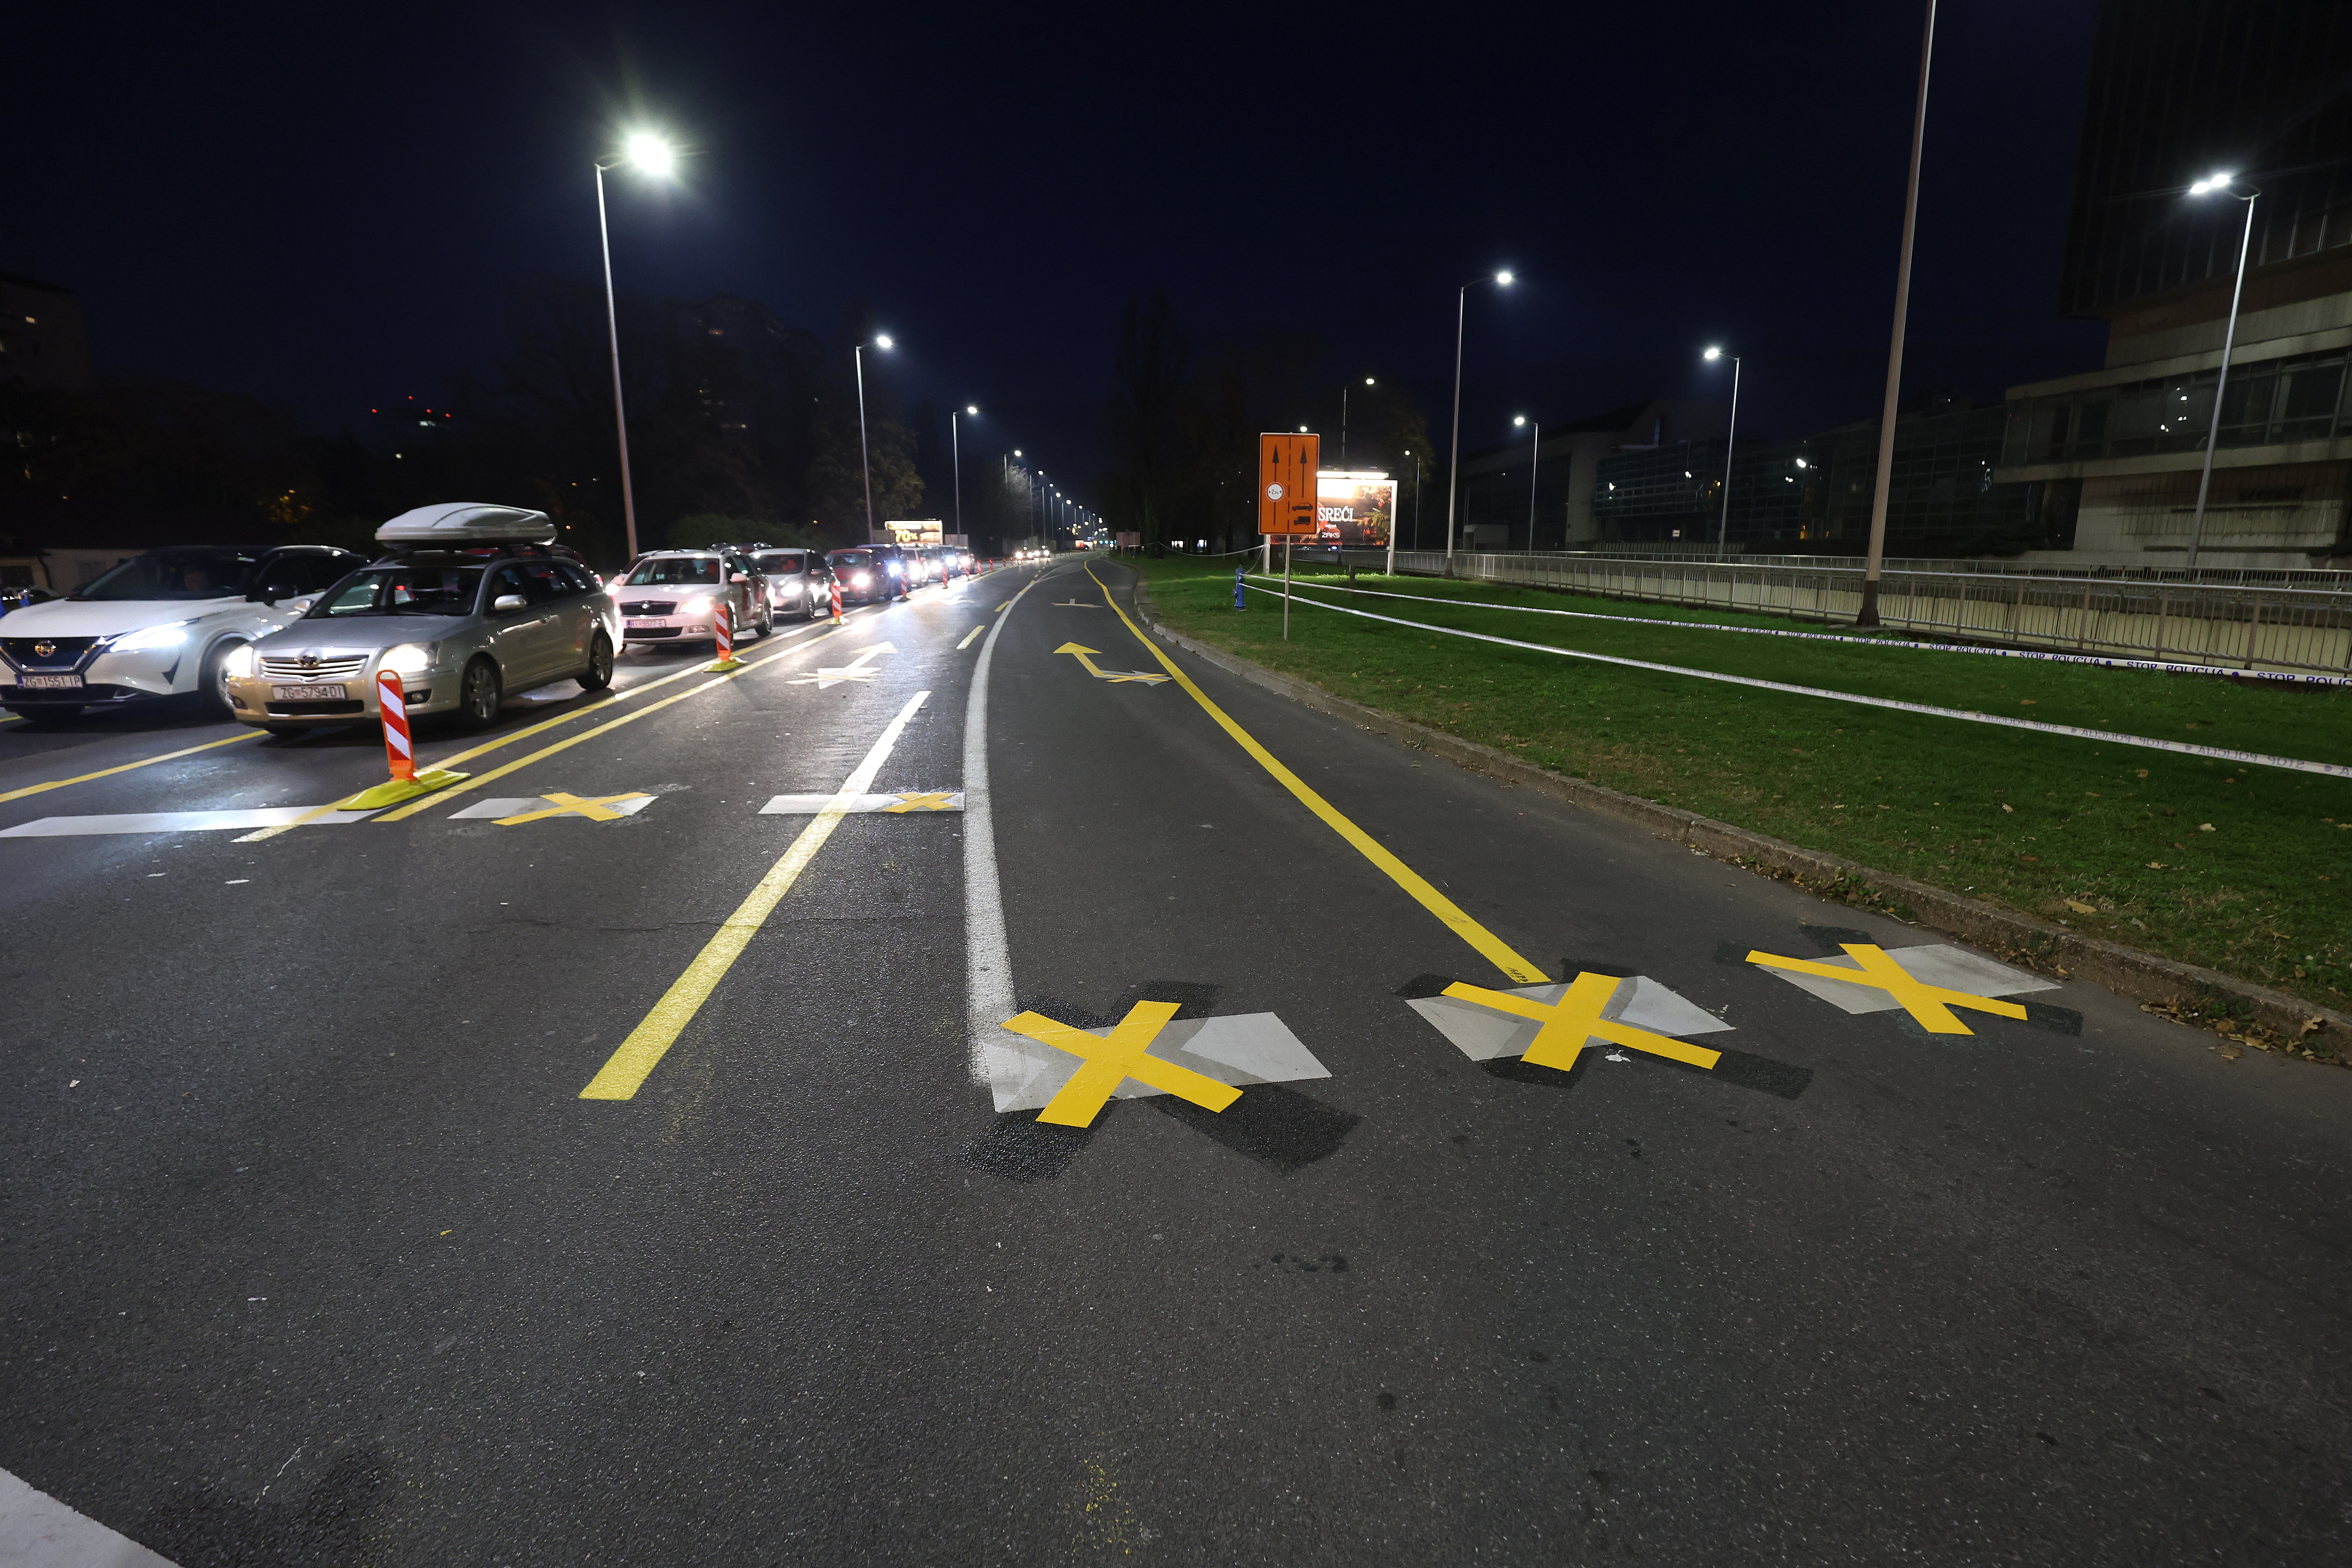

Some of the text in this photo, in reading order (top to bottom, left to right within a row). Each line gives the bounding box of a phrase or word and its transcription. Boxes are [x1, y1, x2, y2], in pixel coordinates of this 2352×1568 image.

[1317, 506, 1354, 522] SREĆI
[895, 530, 918, 541] 70%
[24, 677, 36, 687] ZG
[280, 687, 294, 698] ZG
